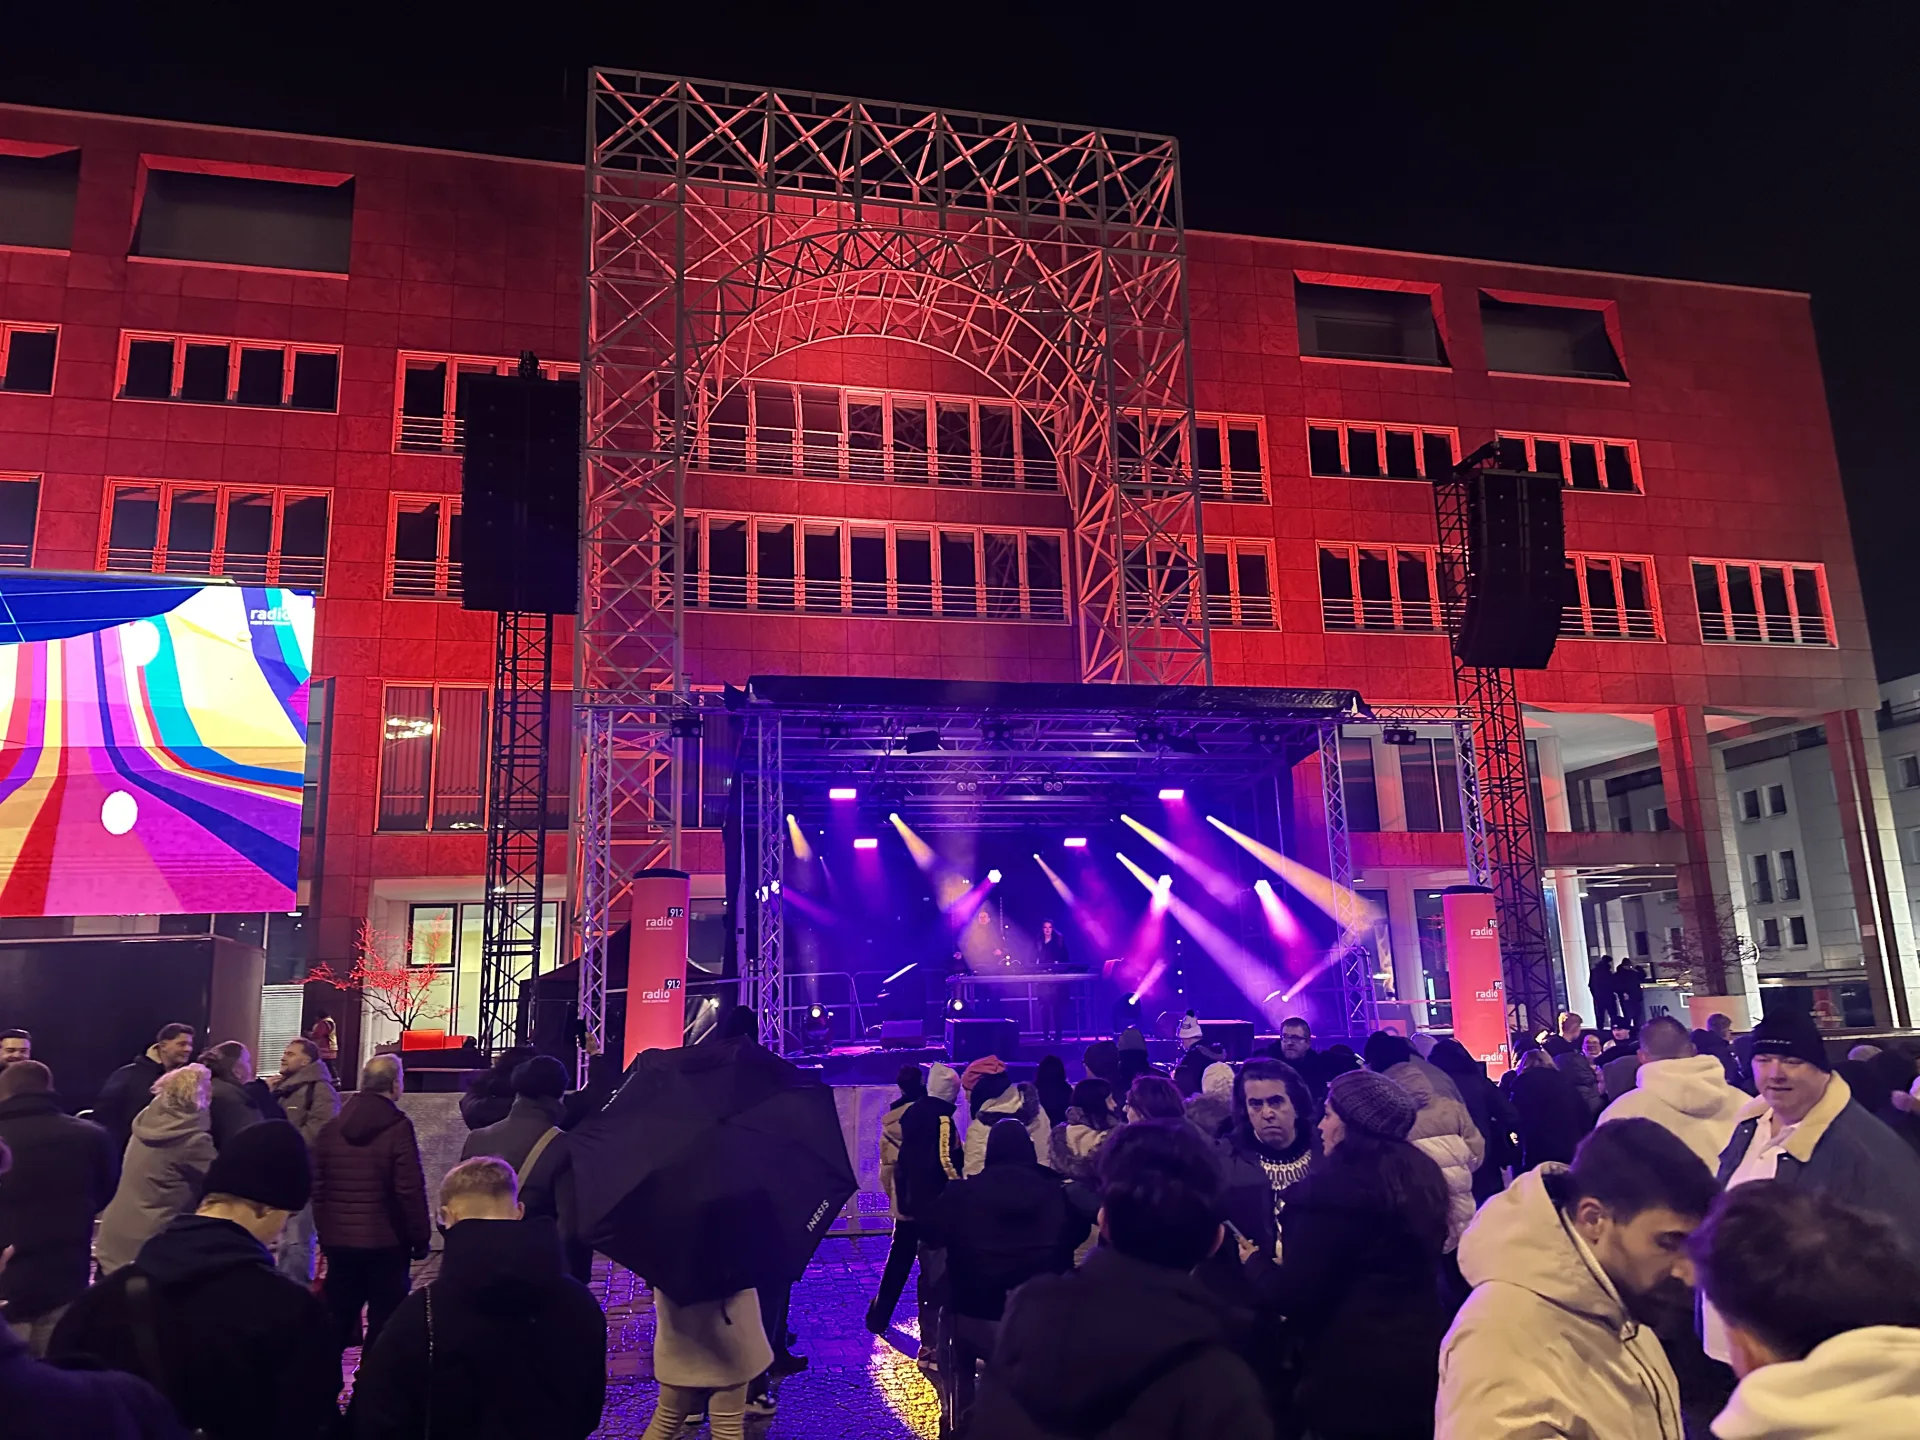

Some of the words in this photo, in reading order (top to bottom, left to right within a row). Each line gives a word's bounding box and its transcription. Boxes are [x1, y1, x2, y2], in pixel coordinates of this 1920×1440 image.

[670, 908, 684, 918] 91.2
[645, 917, 674, 927] radio
[1470, 927, 1493, 936] radio
[642, 989, 670, 999] radio
[1475, 989, 1498, 998] radio
[1649, 1005, 1670, 1019] WC
[1480, 1052, 1504, 1062] radio
[806, 1199, 830, 1232] INESIS
